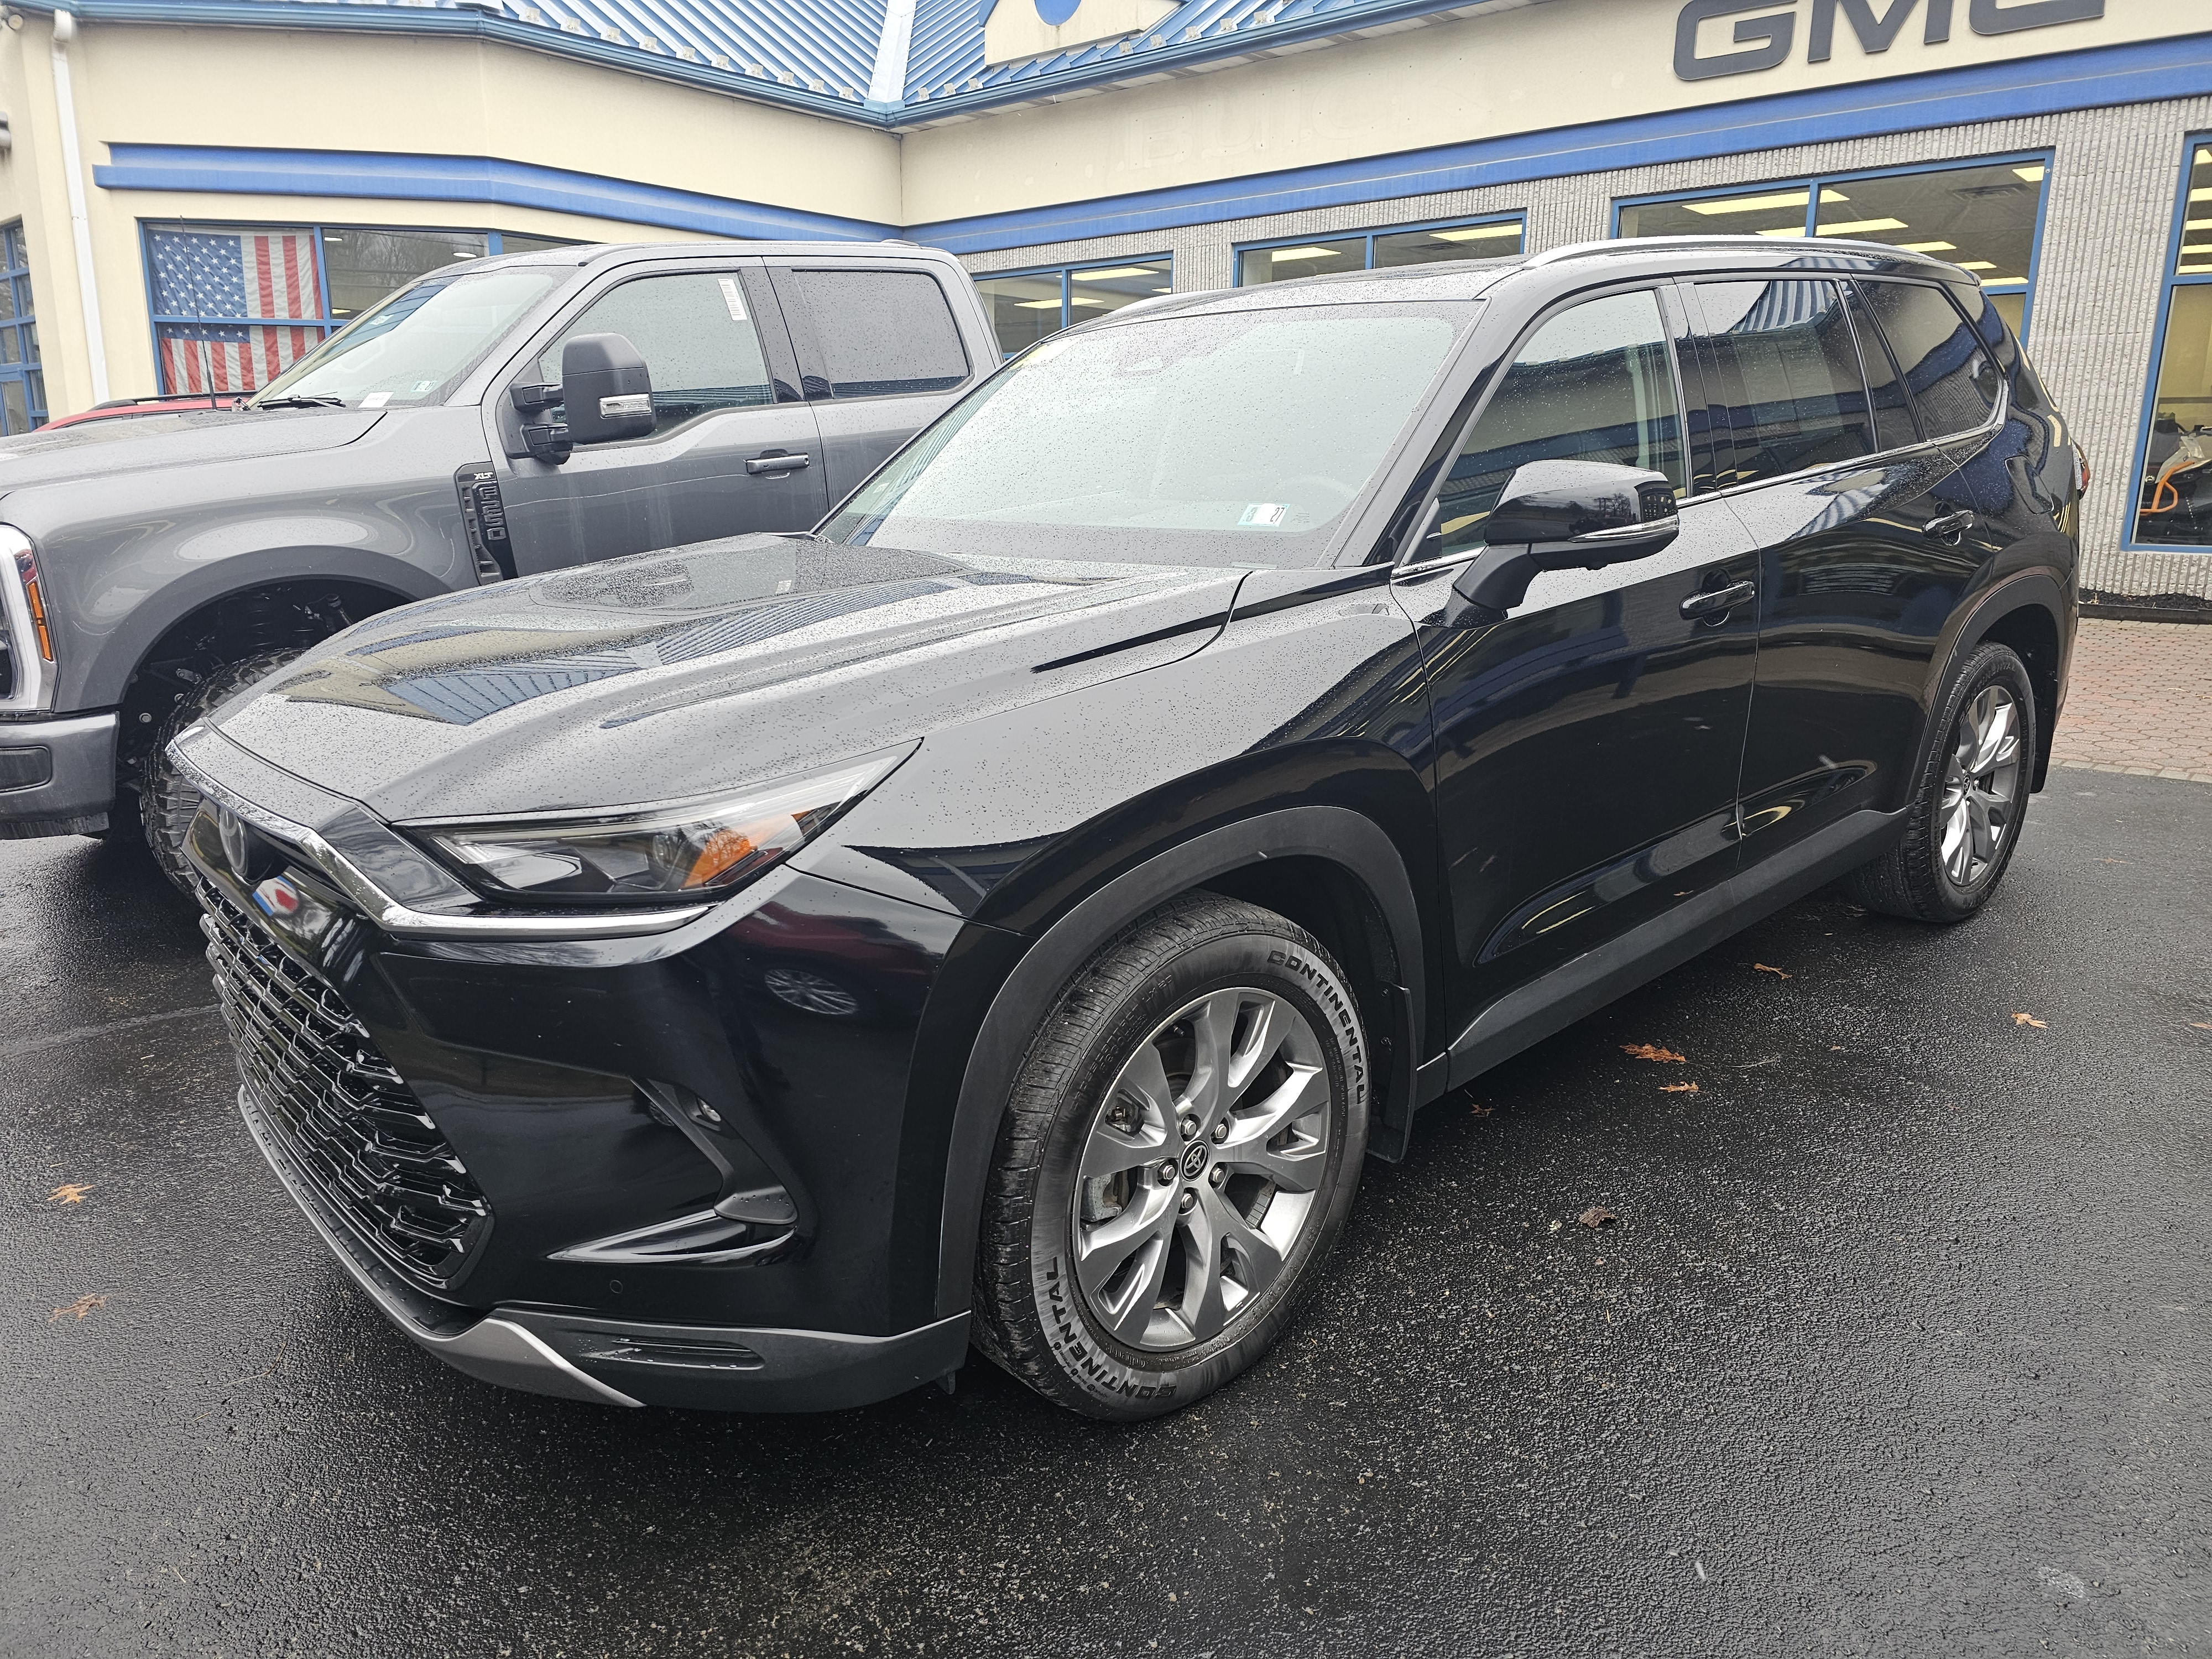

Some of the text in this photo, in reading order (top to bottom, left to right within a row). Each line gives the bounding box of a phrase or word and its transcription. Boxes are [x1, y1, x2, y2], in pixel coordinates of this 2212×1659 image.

[1126, 53, 1491, 171] BUICK
[473, 472, 494, 480] XLT
[479, 486, 507, 540] F250
[1270, 507, 1285, 524] 27
[1266, 950, 1366, 1104] CONTINENTAL
[1046, 1256, 1177, 1400] CONTINENTAL
